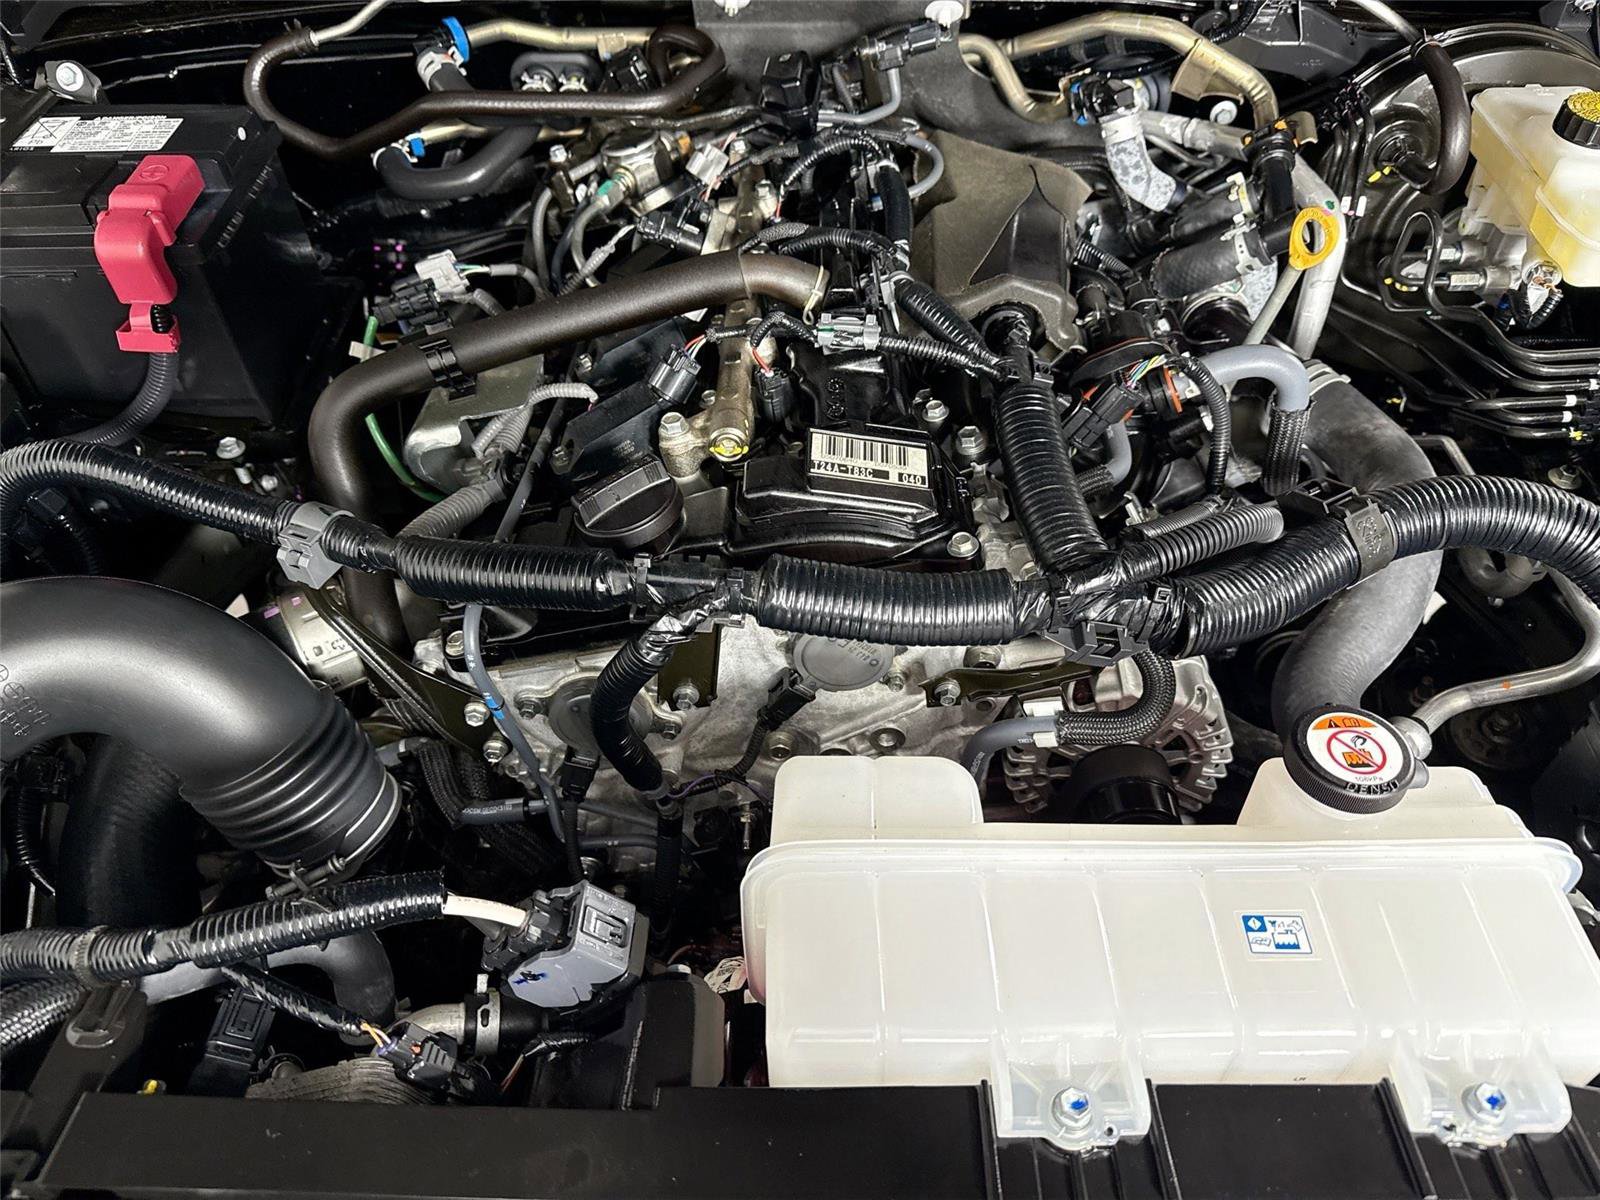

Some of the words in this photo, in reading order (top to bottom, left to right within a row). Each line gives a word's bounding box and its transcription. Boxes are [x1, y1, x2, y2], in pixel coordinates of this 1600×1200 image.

[813, 460, 873, 478] T24A-T83C
[901, 474, 922, 485] 040
[1345, 779, 1400, 795] DENSO
